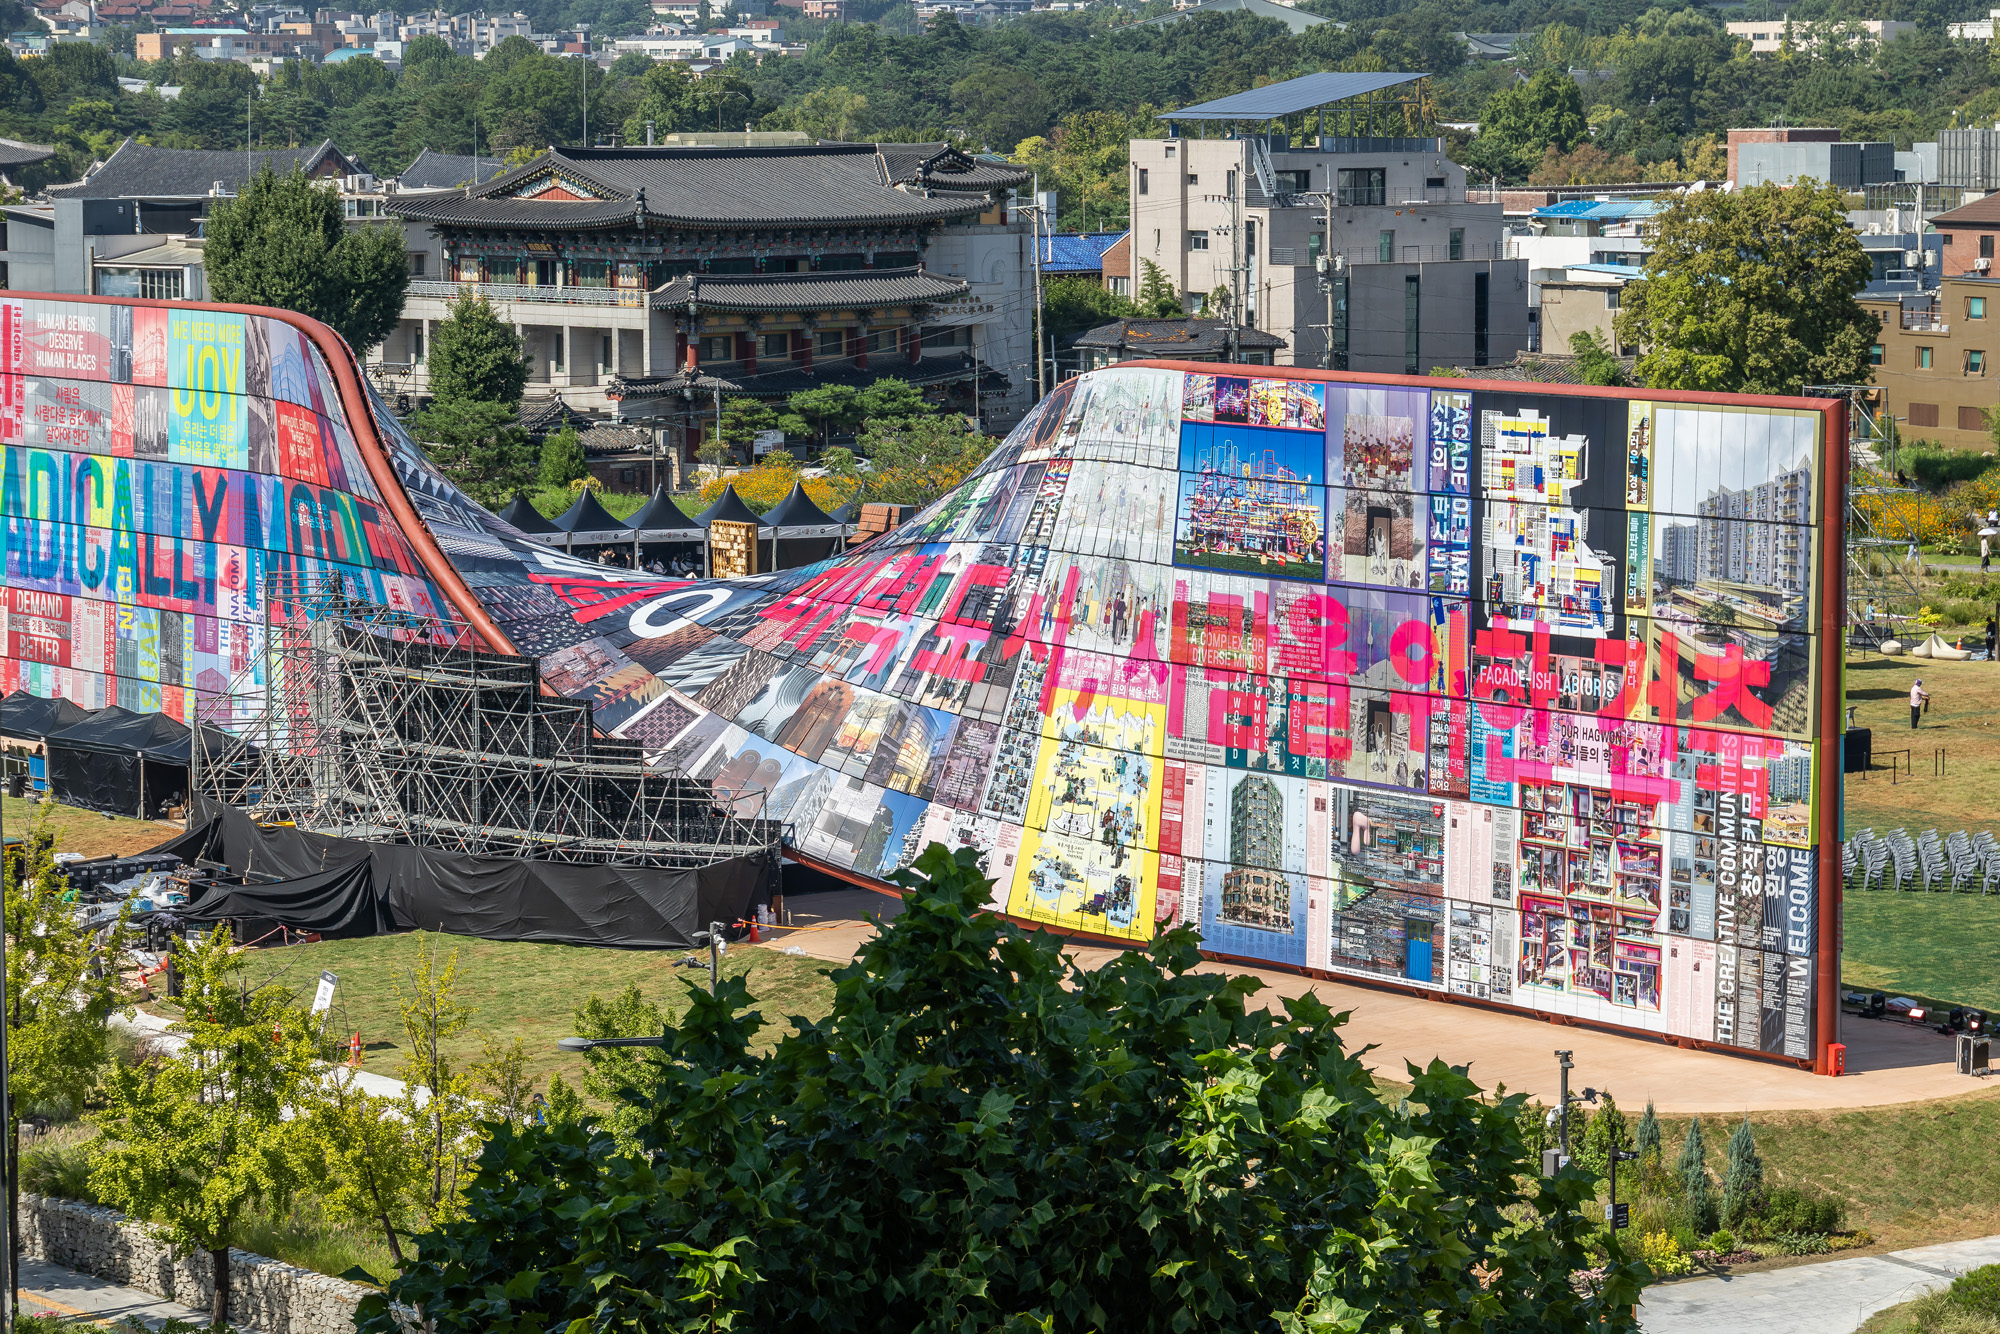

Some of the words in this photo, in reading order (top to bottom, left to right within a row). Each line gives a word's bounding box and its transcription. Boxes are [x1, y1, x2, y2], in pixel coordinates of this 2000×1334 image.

[37, 313, 66, 330] HUMAN
[68, 315, 96, 332] BEINGS
[173, 320, 188, 340] WE
[191, 322, 215, 342] NEED
[219, 324, 241, 344] MORE
[49, 333, 84, 351] DESERVE
[36, 351, 65, 368] HUMAN
[67, 354, 96, 371] PLACES
[173, 344, 240, 421] JOY
[56, 387, 80, 405] 사람은
[34, 405, 66, 424] 사람다운
[69, 408, 102, 427] 공간에서
[46, 427, 70, 444] 살아야
[73, 430, 89, 446] 한다
[183, 421, 207, 438] 우리는
[209, 424, 217, 438] 더
[220, 425, 234, 441] 많은
[1452, 394, 1469, 488] FACADE
[179, 439, 210, 458] 즐거움을
[1642, 468, 1648, 477] OF
[0, 446, 231, 608] ADICALLY
[1027, 501, 1044, 536] THE
[230, 548, 240, 628] ANATOMY
[17, 590, 62, 619] DEMAND
[243, 584, 254, 647] JOYFUL
[12, 617, 17, 626] 더
[20, 618, 30, 631] 나은
[32, 619, 43, 632] 것을
[220, 619, 229, 649] THE
[20, 634, 59, 663] BETTER
[105, 644, 110, 652] TO
[1191, 631, 1197, 644] A
[1200, 632, 1243, 650] COMPLEX
[1247, 636, 1264, 653] FOR
[140, 610, 160, 711] SUAL
[184, 616, 195, 720] COMPLEXITY
[1193, 648, 1231, 666] DIVERSE
[1234, 653, 1264, 670] MINDS
[1479, 666, 1552, 690] FACADE-ISH
[1556, 674, 1615, 699] LAB(OR)S
[1431, 699, 1438, 708] IF
[1431, 711, 1448, 720] LOVE
[1448, 713, 1466, 723] SEOUL
[1431, 734, 1449, 745] WEAR
[1450, 737, 1456, 746] IT
[1444, 724, 1457, 734] CAN
[1561, 723, 1579, 739] OUR
[1582, 726, 1622, 746] HAGWON
[1291, 757, 1300, 770] 것
[1431, 755, 1464, 770] 사랑한다면
[1560, 744, 1599, 763] 우리들의
[1430, 779, 1450, 791] 있어요
[1719, 734, 1737, 885] COMMUNITIES
[1765, 847, 1787, 899] 환영
[1788, 850, 1809, 977] WELCOME
[1718, 893, 1735, 995] CREATIVE
[1718, 1000, 1734, 1041] THE
